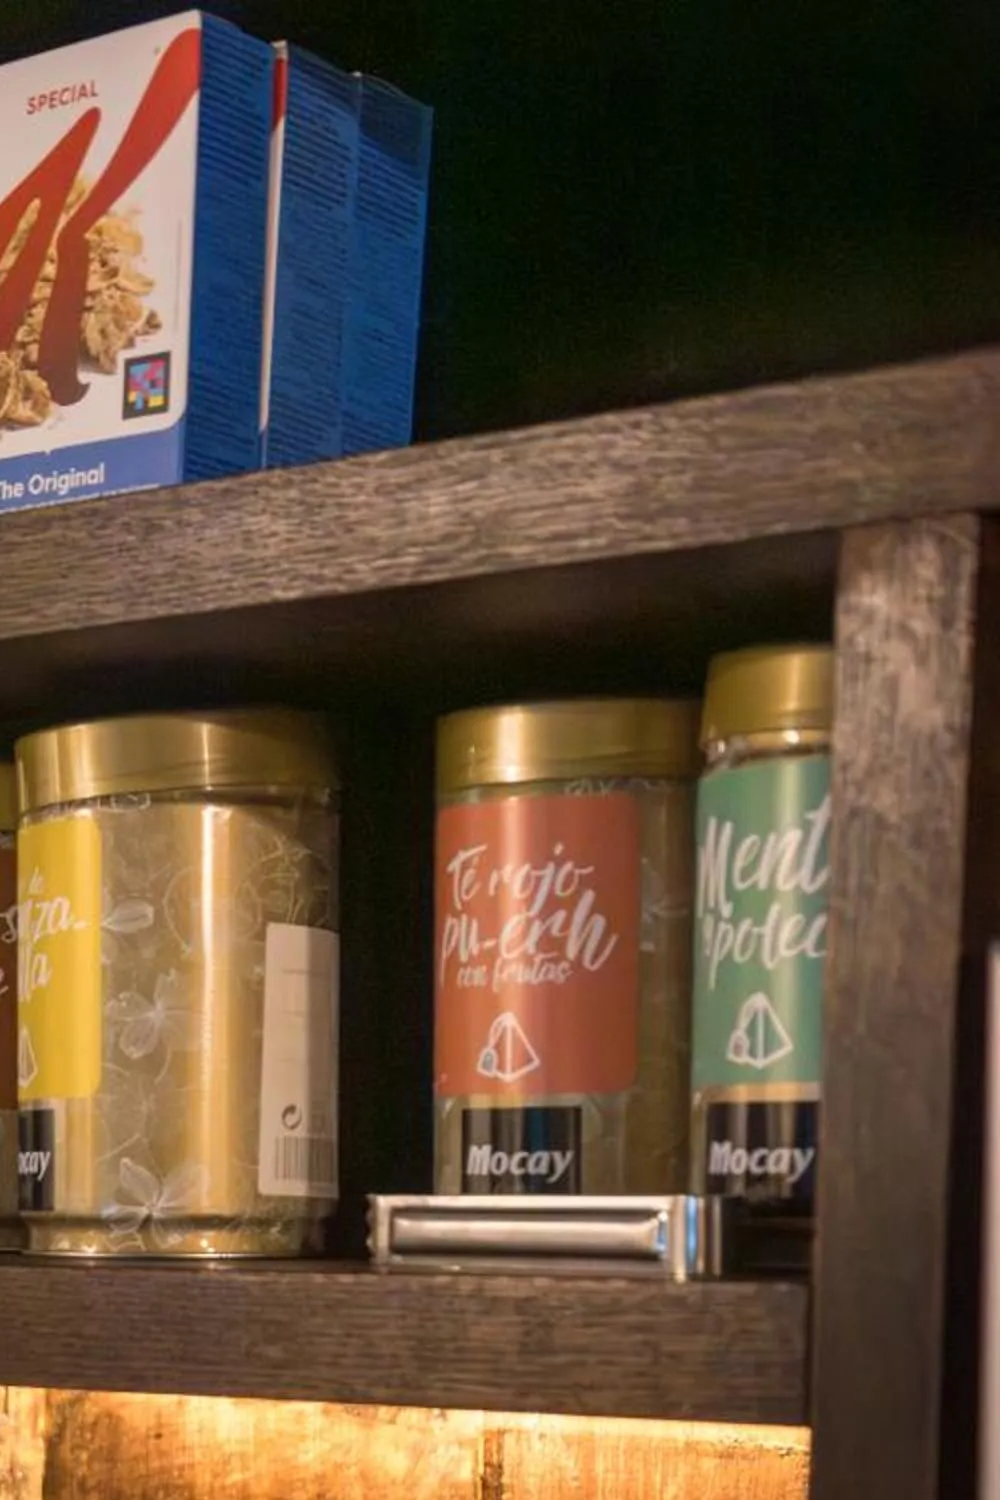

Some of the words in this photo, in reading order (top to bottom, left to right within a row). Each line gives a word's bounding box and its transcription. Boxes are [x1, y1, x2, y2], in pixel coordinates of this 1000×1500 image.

[26, 80, 99, 115] SPECIAL
[28, 462, 105, 496] Original
[698, 794, 834, 919] Ment
[446, 844, 488, 911] Té
[488, 841, 596, 918] rojo
[438, 888, 619, 990] pu-erh
[466, 1144, 573, 1184] Mocay
[708, 1141, 815, 1184] Mocay
